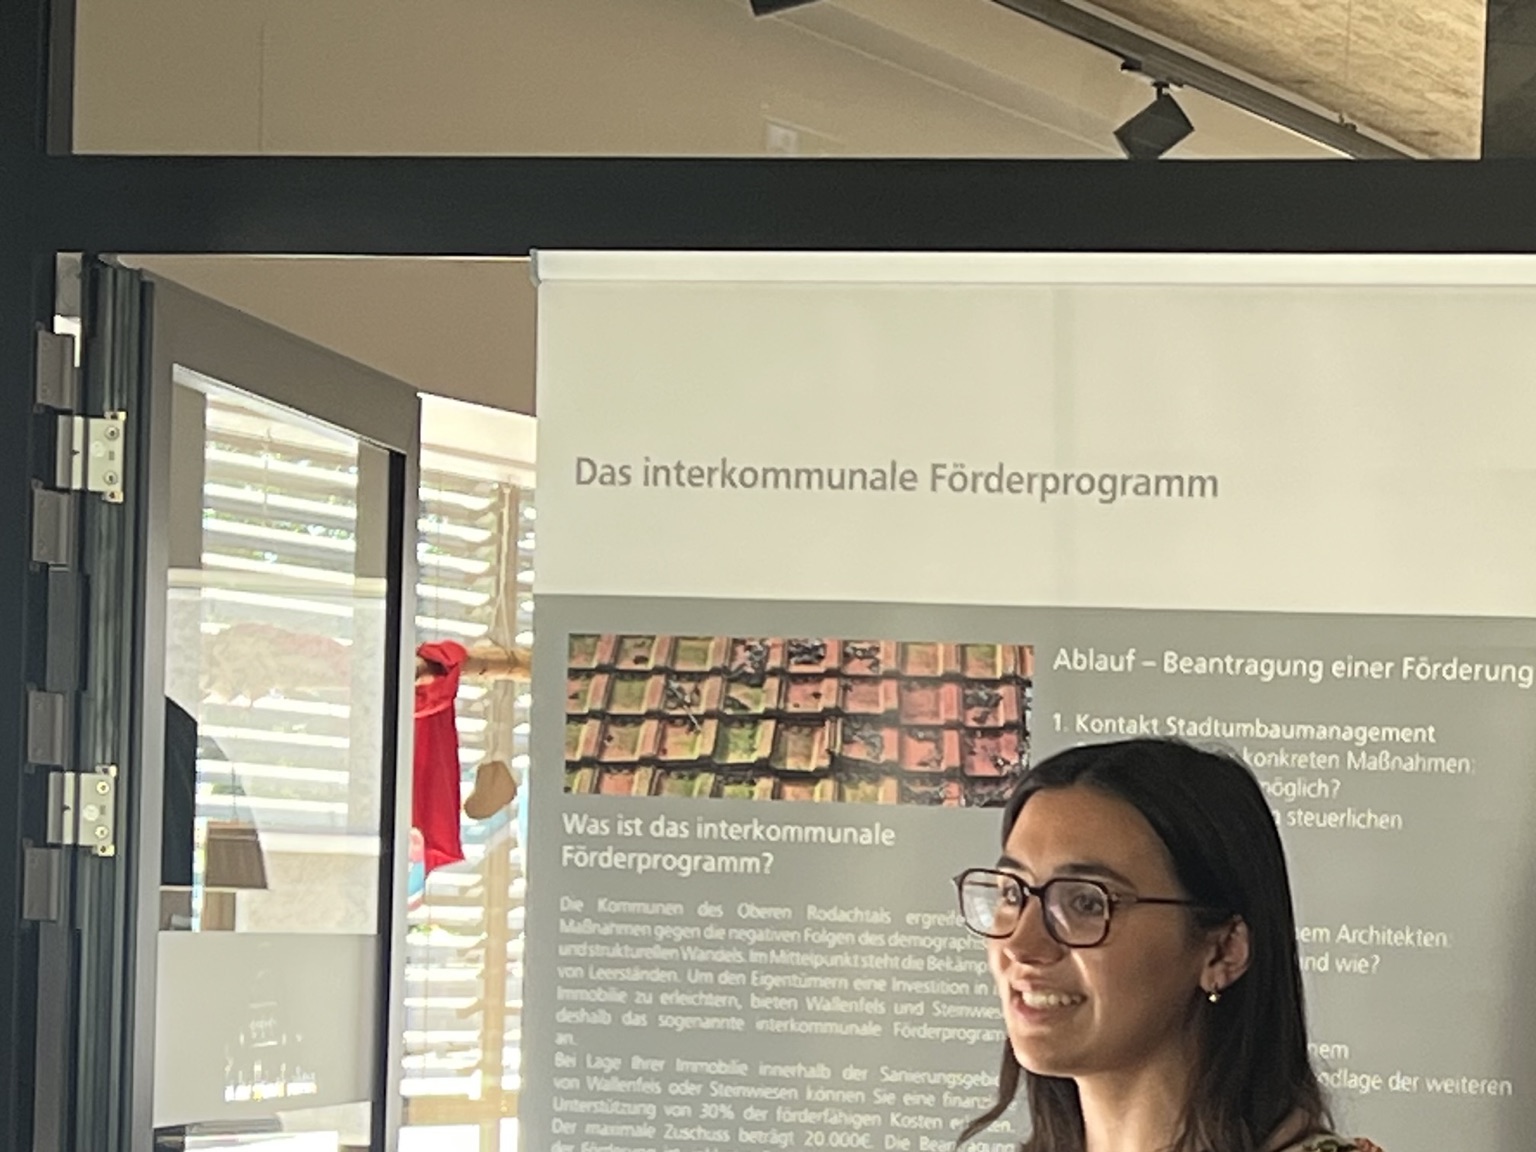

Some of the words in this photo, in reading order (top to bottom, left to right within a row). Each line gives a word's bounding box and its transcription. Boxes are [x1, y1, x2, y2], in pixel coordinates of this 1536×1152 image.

[575, 456, 633, 486] Das
[642, 456, 918, 492] interkommunale
[930, 461, 1218, 504] Förderprogramm
[1053, 648, 1136, 672] Ablauf
[1163, 651, 1324, 683] Beantragung
[1331, 654, 1395, 679] einer
[1402, 656, 1534, 688] Förderung
[1053, 712, 1069, 732] 1.
[1075, 713, 1159, 735] Kontakt
[1166, 716, 1436, 746] Stadtumbaumanagement
[1242, 747, 1340, 770] konkreten
[561, 810, 610, 835] Was
[616, 812, 643, 836] ist
[649, 813, 690, 838] das
[696, 815, 895, 845] interkommunale
[1287, 806, 1403, 830] steuerlichen
[562, 843, 774, 876] Förderprogramm?
[560, 895, 583, 911] Die
[597, 897, 684, 915] Kommunen
[697, 900, 723, 916] des
[737, 902, 792, 919] Oberen
[806, 905, 891, 923] Rodachtals
[905, 910, 967, 929] ergreife
[654, 925, 700, 943] gegen
[704, 924, 725, 940] die
[728, 926, 801, 945] negativen
[803, 928, 855, 949] Folgen
[857, 930, 886, 946] des
[1335, 954, 1381, 974] wie?
[557, 966, 584, 979] von
[687, 969, 713, 985] Um
[717, 970, 746, 986] den
[852, 976, 888, 992] eine
[891, 977, 969, 995] Investition
[634, 991, 653, 1004] zu
[750, 993, 798, 1010] bieten
[893, 1000, 925, 1016] und
[621, 1010, 648, 1026] das
[657, 1014, 745, 1032] sogenannte
[755, 1016, 882, 1036] interkommunale
[585, 1053, 622, 1074] Lage
[758, 1061, 831, 1080] innerhalb
[841, 1065, 868, 1081] der
[552, 1077, 580, 1090] von
[668, 1080, 703, 1096] oder
[805, 1086, 865, 1103] können
[872, 1089, 895, 1105] Sie
[902, 1090, 936, 1107] eine
[1388, 1070, 1420, 1092] der
[1425, 1076, 1513, 1096] weiteren
[662, 1104, 692, 1117] von
[699, 1103, 735, 1119] 30%
[742, 1105, 768, 1121] der
[890, 1112, 943, 1129] Kosten
[551, 1118, 577, 1134] Der
[663, 1123, 730, 1141] Zuschuss
[738, 1127, 794, 1149] beträgt
[884, 1133, 911, 1150] Die
